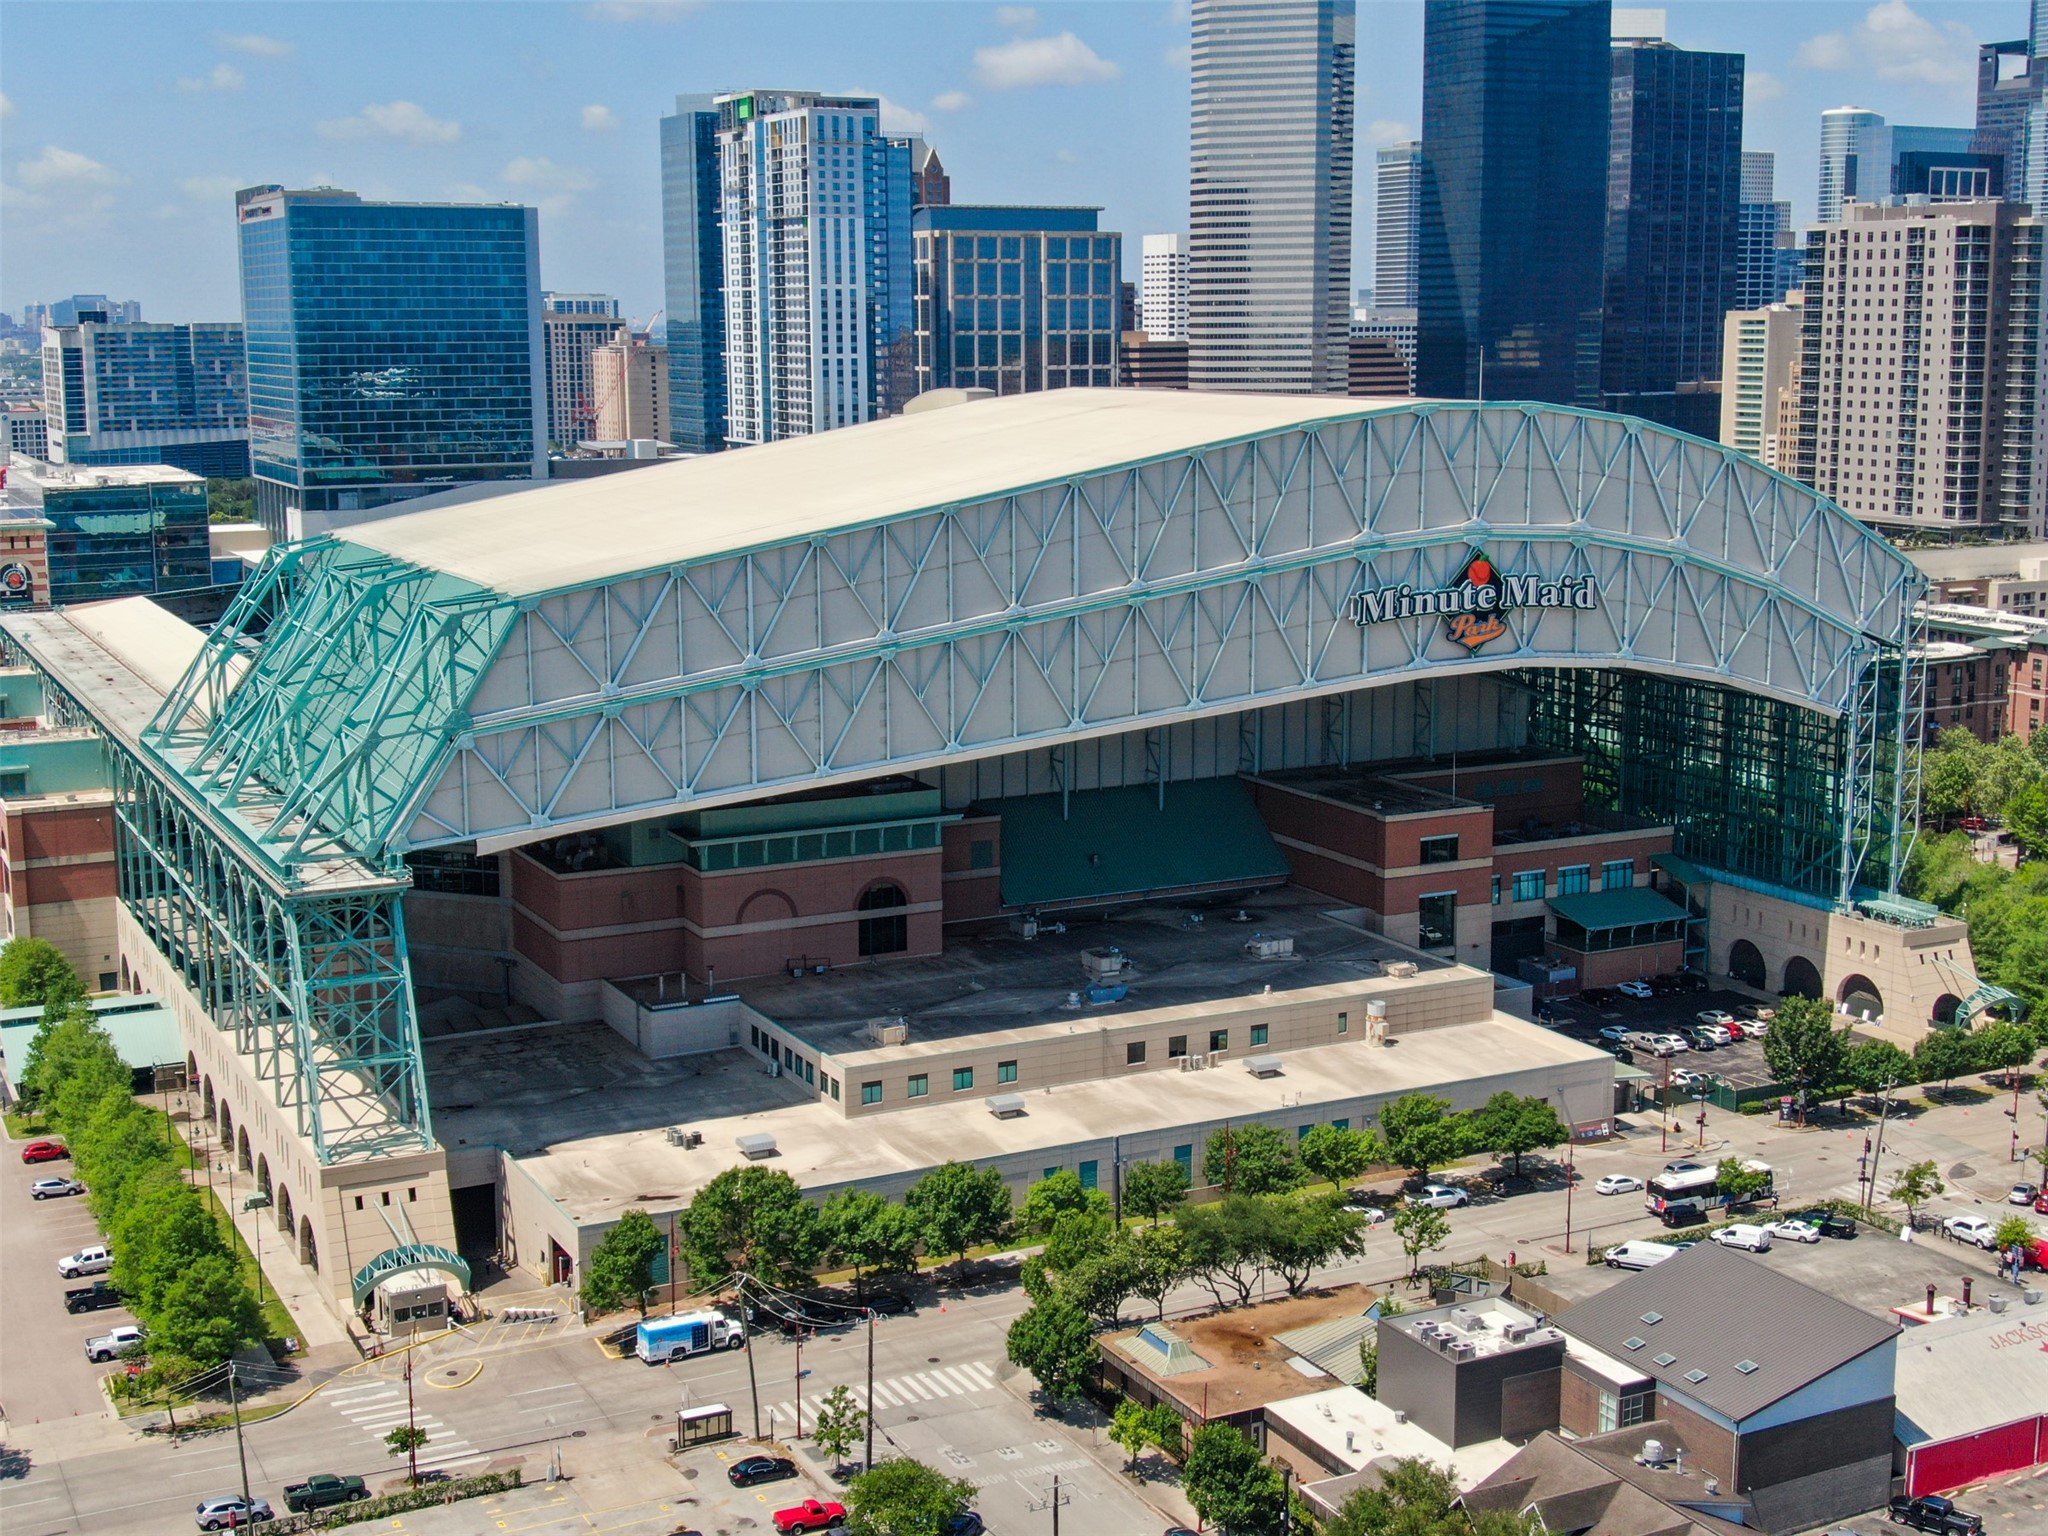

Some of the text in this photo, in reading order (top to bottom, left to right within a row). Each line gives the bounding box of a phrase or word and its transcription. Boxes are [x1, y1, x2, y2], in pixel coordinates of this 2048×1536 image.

[1356, 573, 1597, 626] Minute Maid
[1447, 613, 1501, 641] Park
[1988, 1321, 2048, 1350] JACKSO
